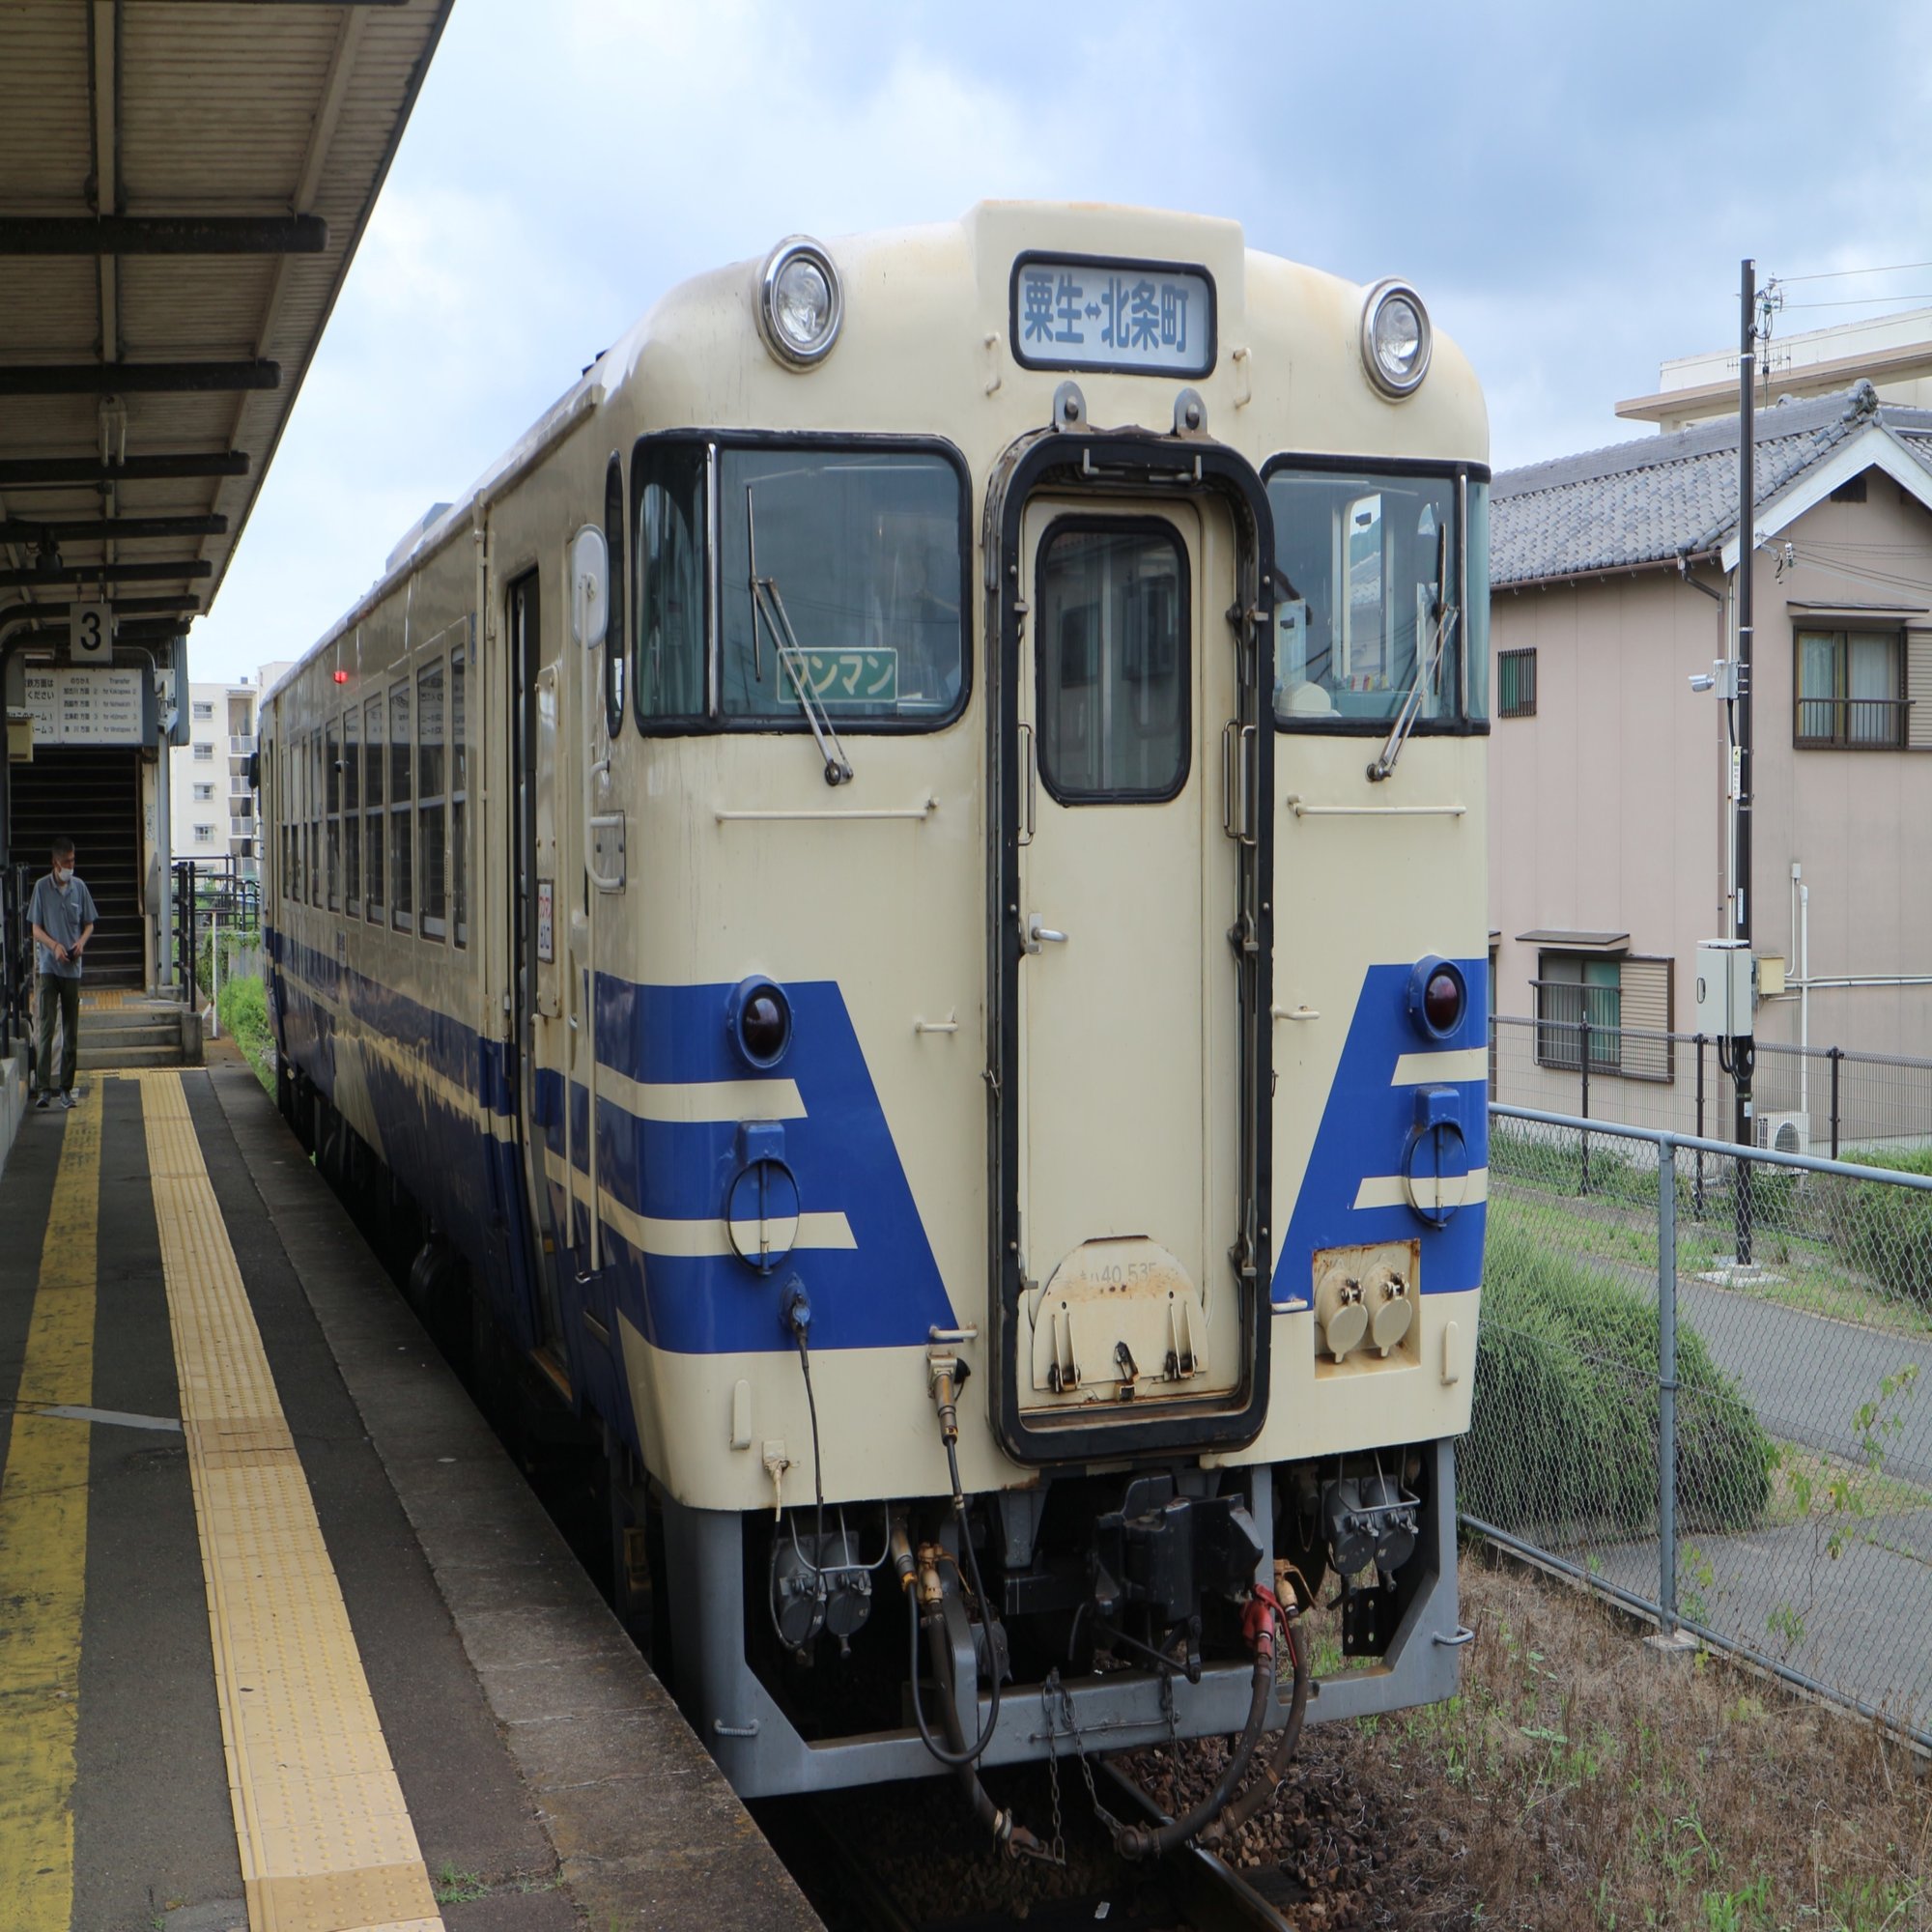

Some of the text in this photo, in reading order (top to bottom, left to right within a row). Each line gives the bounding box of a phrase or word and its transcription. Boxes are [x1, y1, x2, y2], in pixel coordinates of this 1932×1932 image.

[1024, 272, 1190, 353] 粟生 北条町
[80, 611, 101, 651] 3
[783, 655, 894, 696] ワンマン
